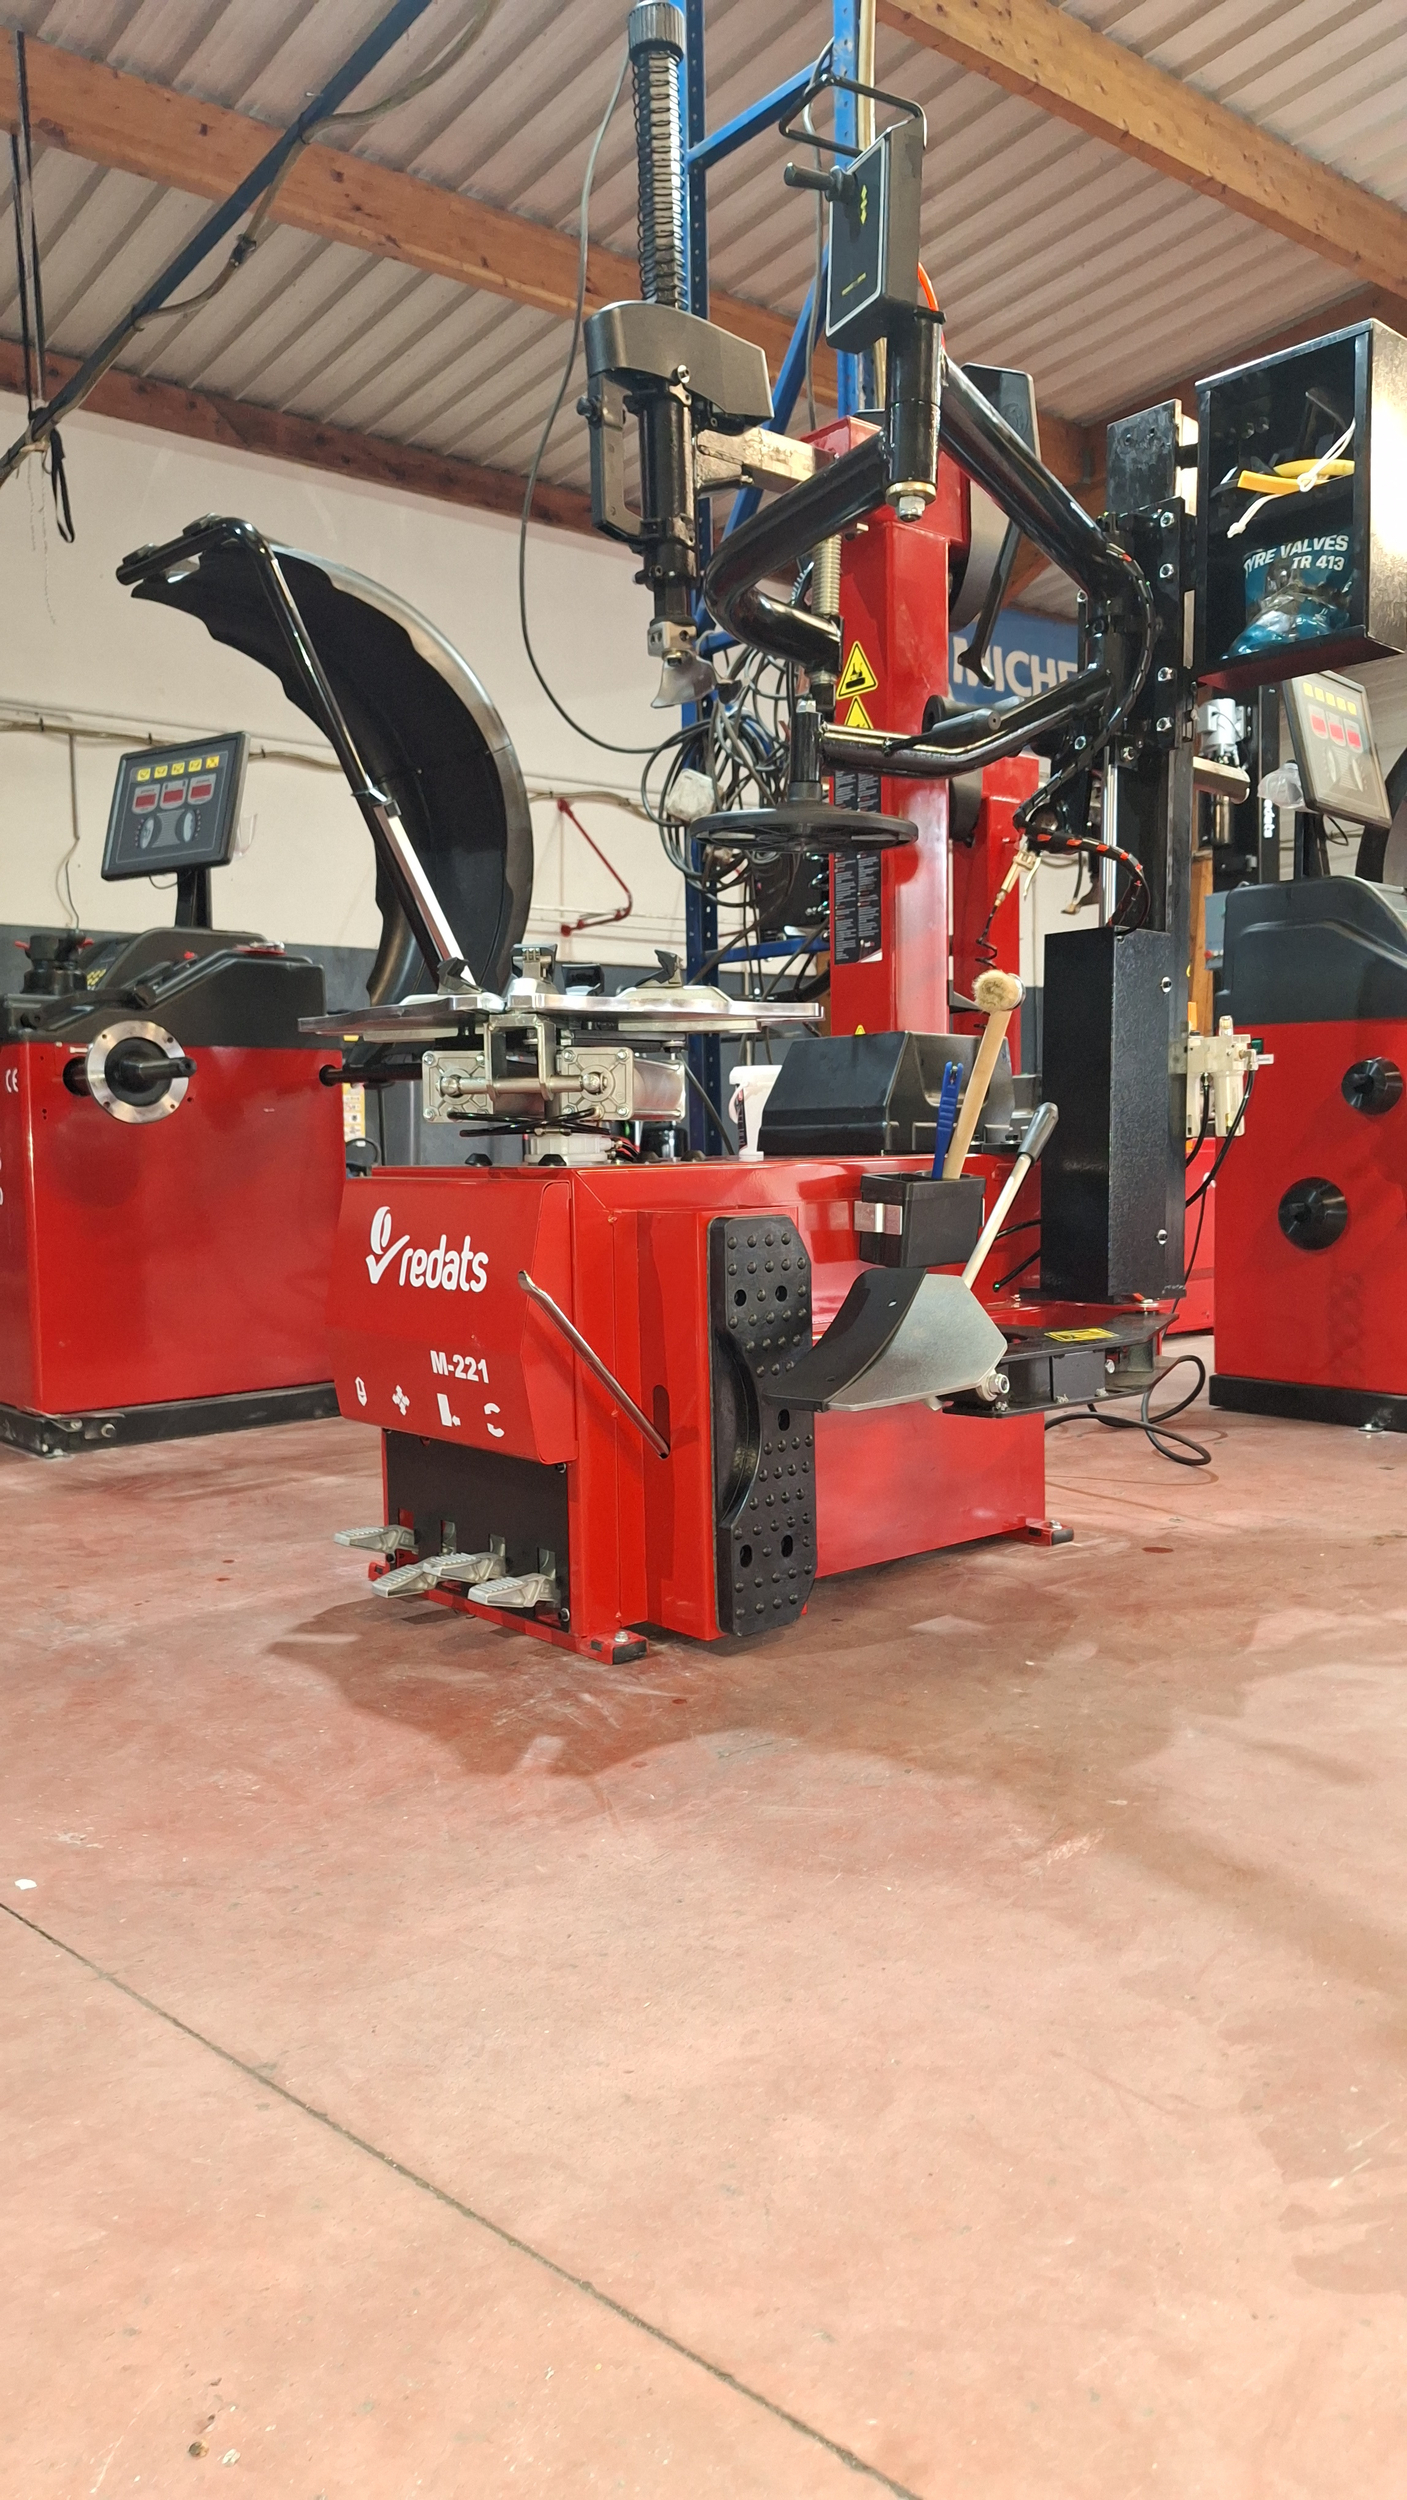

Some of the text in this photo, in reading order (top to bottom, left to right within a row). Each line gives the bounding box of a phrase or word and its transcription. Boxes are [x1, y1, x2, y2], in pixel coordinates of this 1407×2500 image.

[1243, 535, 1350, 579] TYRE VALVES
[1291, 555, 1346, 571] TR 413
[398, 1233, 490, 1293] redats
[429, 1350, 490, 1384] M-221
